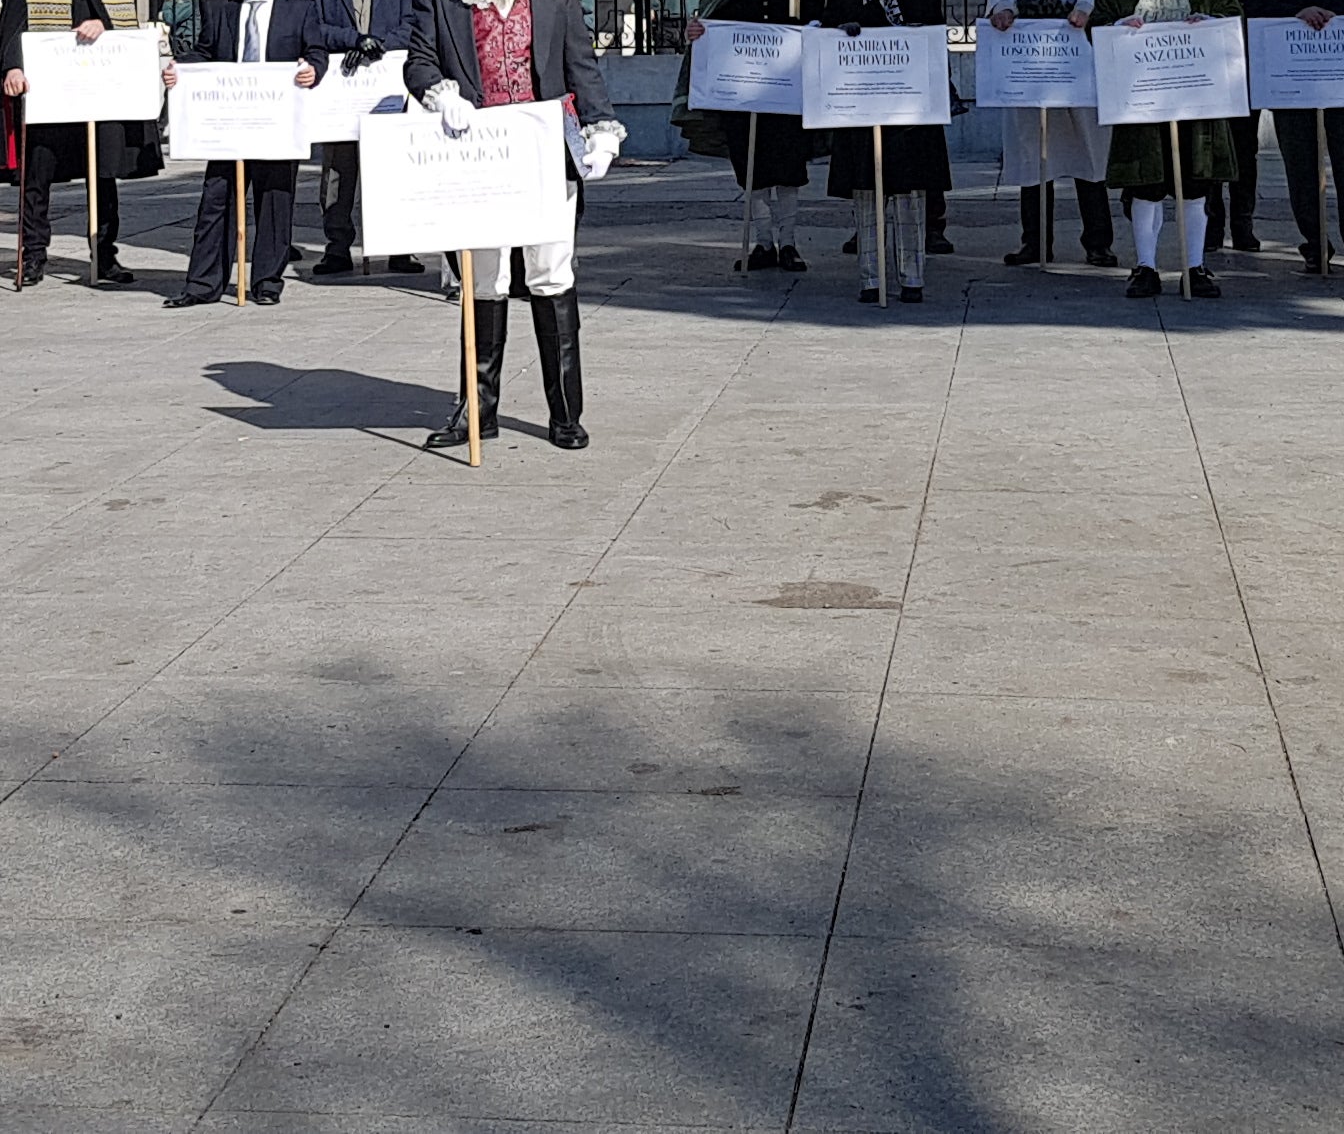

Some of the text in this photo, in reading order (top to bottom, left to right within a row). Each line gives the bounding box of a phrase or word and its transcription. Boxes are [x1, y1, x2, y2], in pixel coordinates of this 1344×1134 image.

[1013, 33, 1070, 44] FRANCISCO
[1145, 33, 1191, 49] GASPAR
[1285, 29, 1323, 41] PEDRO
[734, 46, 780, 59] SORIANO
[838, 40, 887, 53] PALMIRA
[1001, 46, 1079, 57] LOSCOS BERNAL
[1290, 43, 1344, 55] ENTRALGO
[1134, 46, 1205, 64] SANZ CELMA
